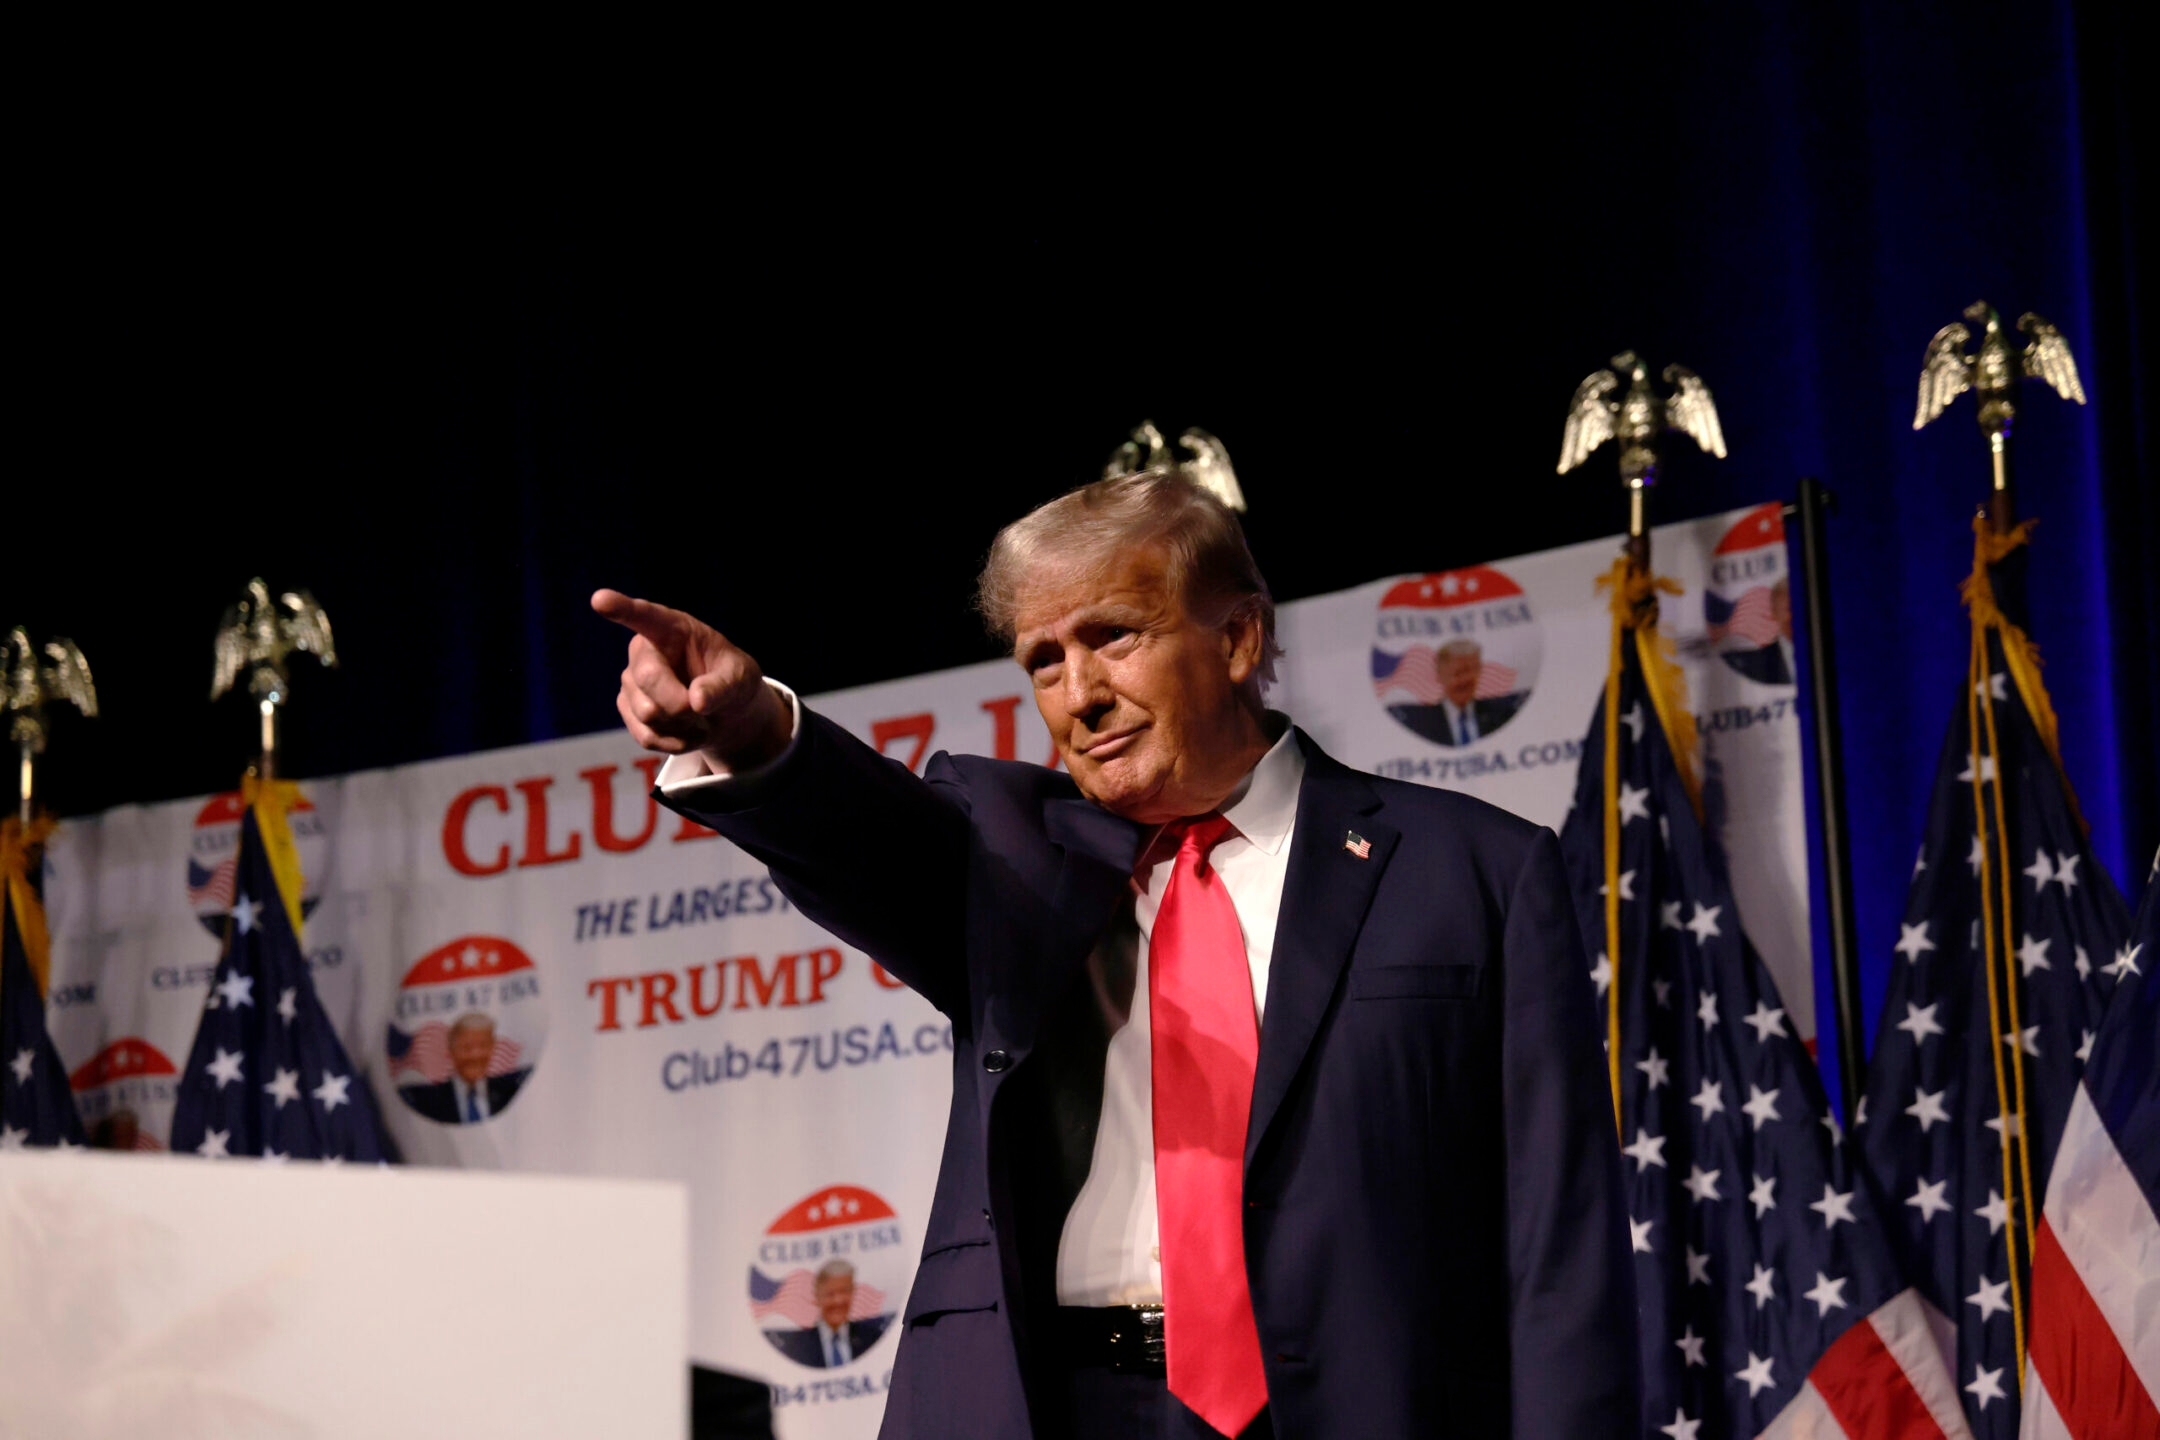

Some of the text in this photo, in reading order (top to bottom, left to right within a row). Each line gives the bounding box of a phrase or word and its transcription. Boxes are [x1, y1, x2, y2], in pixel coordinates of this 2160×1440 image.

[1712, 553, 1776, 583] CLUB
[1376, 614, 1443, 639] CLUB
[1484, 603, 1533, 630] USA
[442, 757, 720, 877] CLU
[575, 898, 638, 942] THE
[396, 988, 460, 1018] CLUB
[499, 975, 540, 1005] USA
[587, 946, 844, 1033] TRUMP
[759, 1236, 822, 1263] CLUB
[858, 1224, 902, 1250] USA
